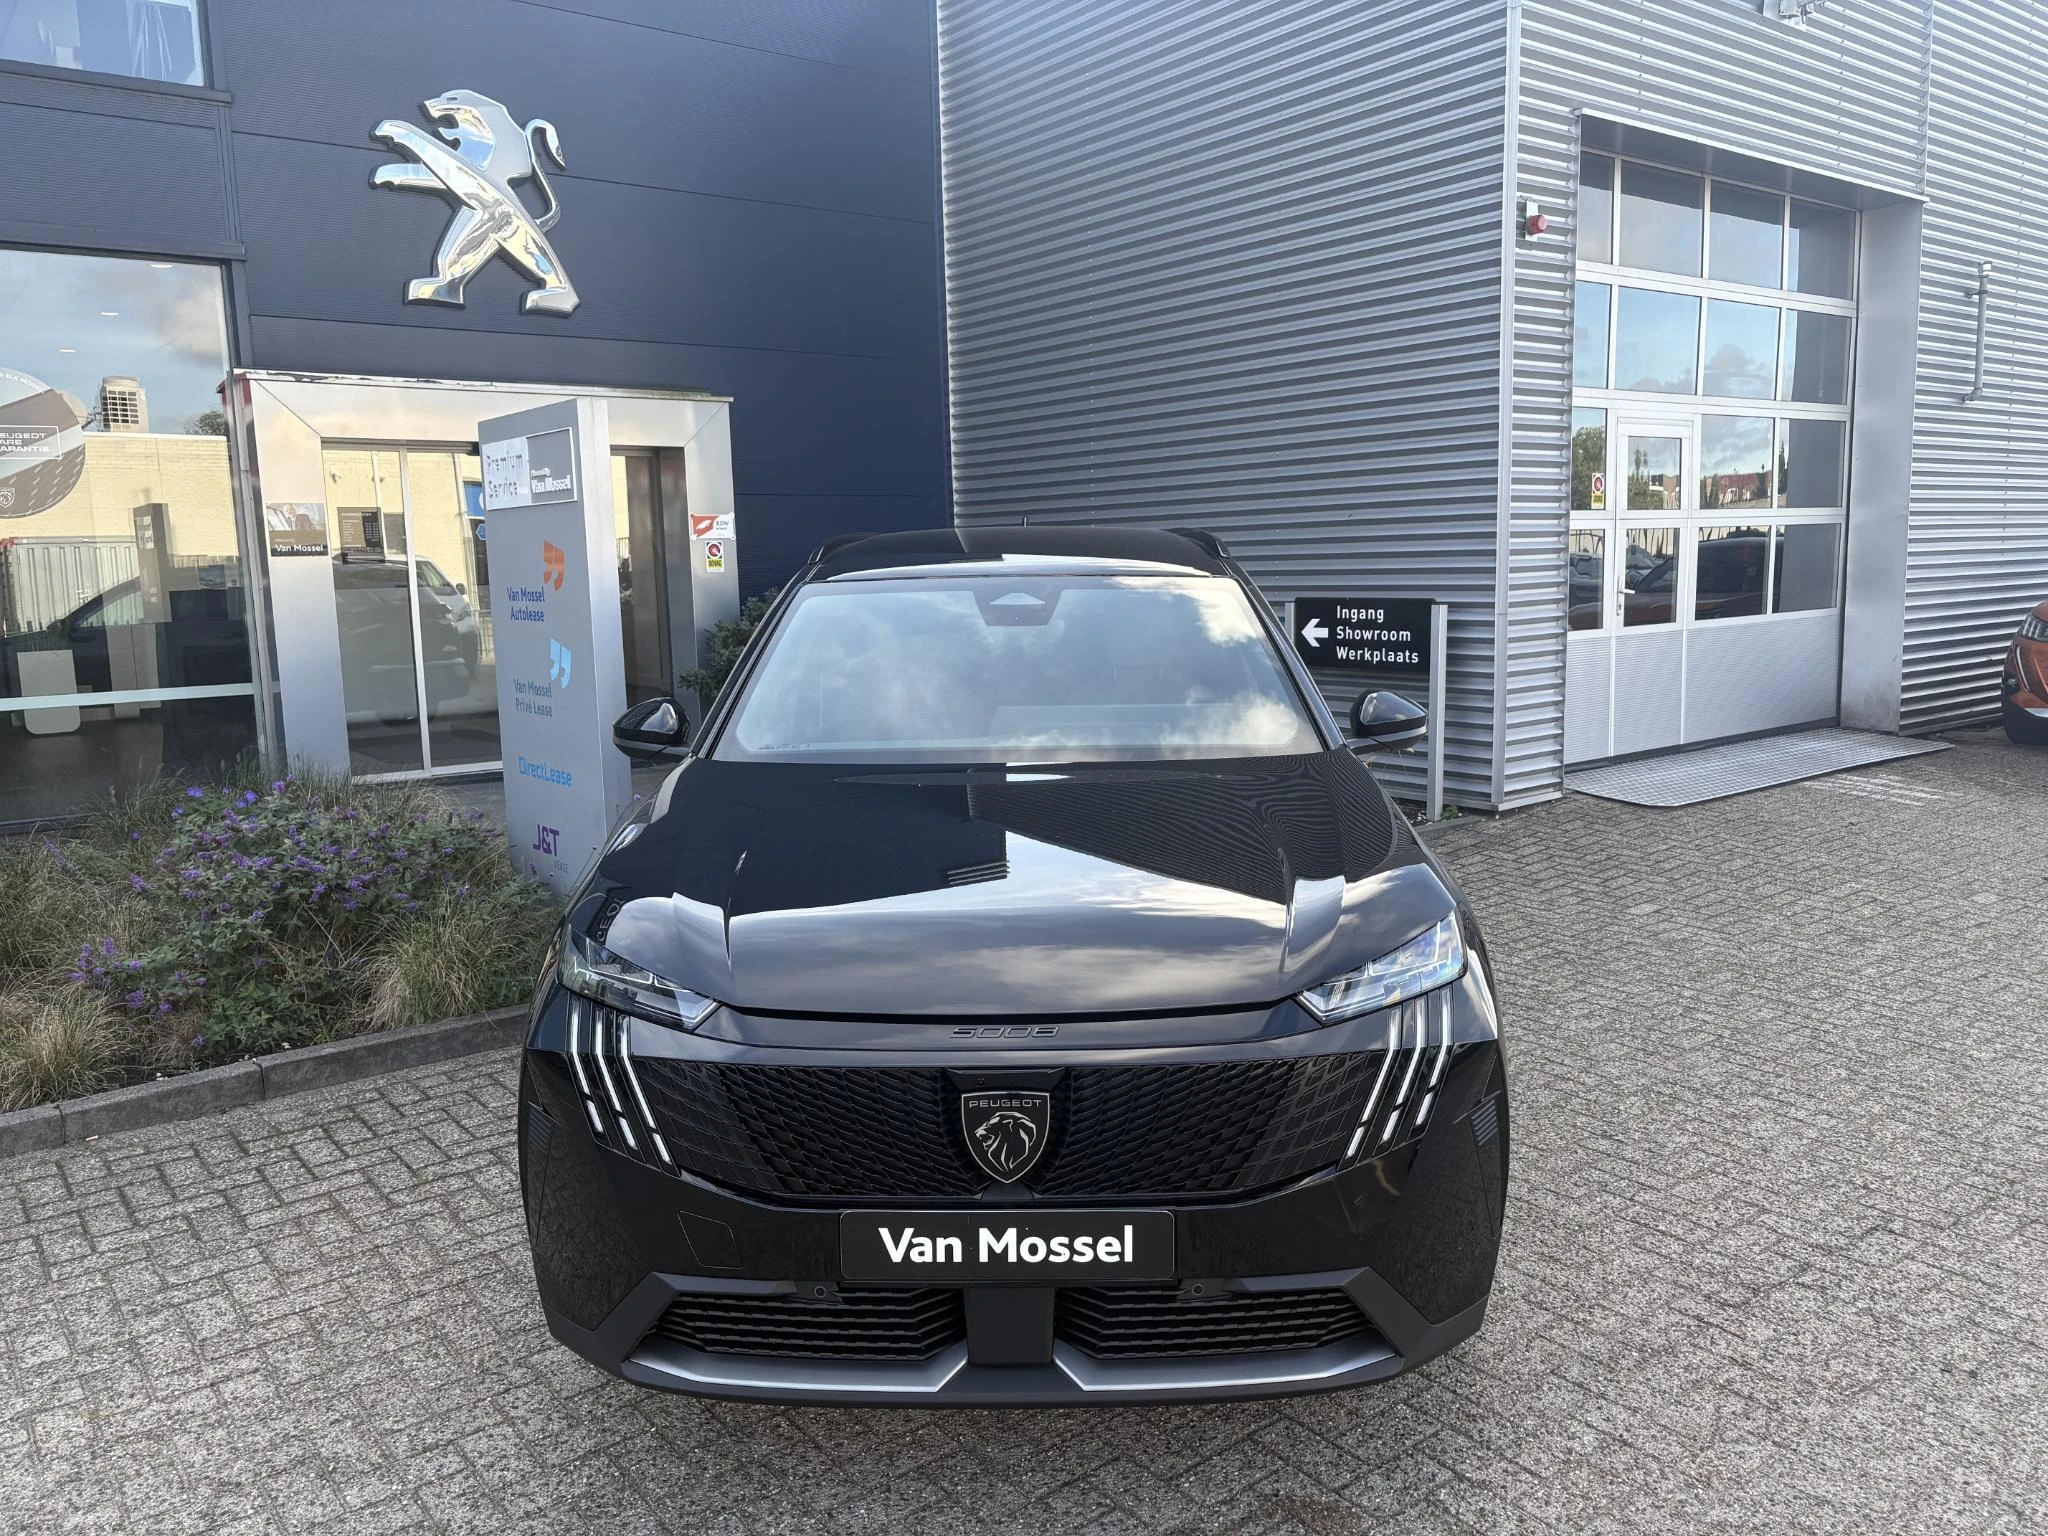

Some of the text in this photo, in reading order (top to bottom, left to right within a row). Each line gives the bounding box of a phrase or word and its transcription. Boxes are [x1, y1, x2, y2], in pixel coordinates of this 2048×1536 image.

[486, 451, 524, 475] Premium
[489, 478, 519, 498] Service
[531, 475, 571, 494] Van Mossel
[275, 543, 324, 552] Van Mossel
[506, 586, 545, 602] Van Mossel
[510, 605, 545, 622] Autolease
[1336, 605, 1384, 623] Ingang
[1336, 625, 1411, 642] Showroom
[1336, 645, 1419, 665] Werkplaats
[513, 678, 553, 699] Van Mossel
[533, 699, 553, 718] Lease
[518, 755, 573, 787] DirectLease
[533, 824, 560, 857] J&T
[949, 1025, 1060, 1038] 5008
[969, 1099, 1042, 1109] PEUGEOT
[878, 1225, 1133, 1263] Van Mossel
